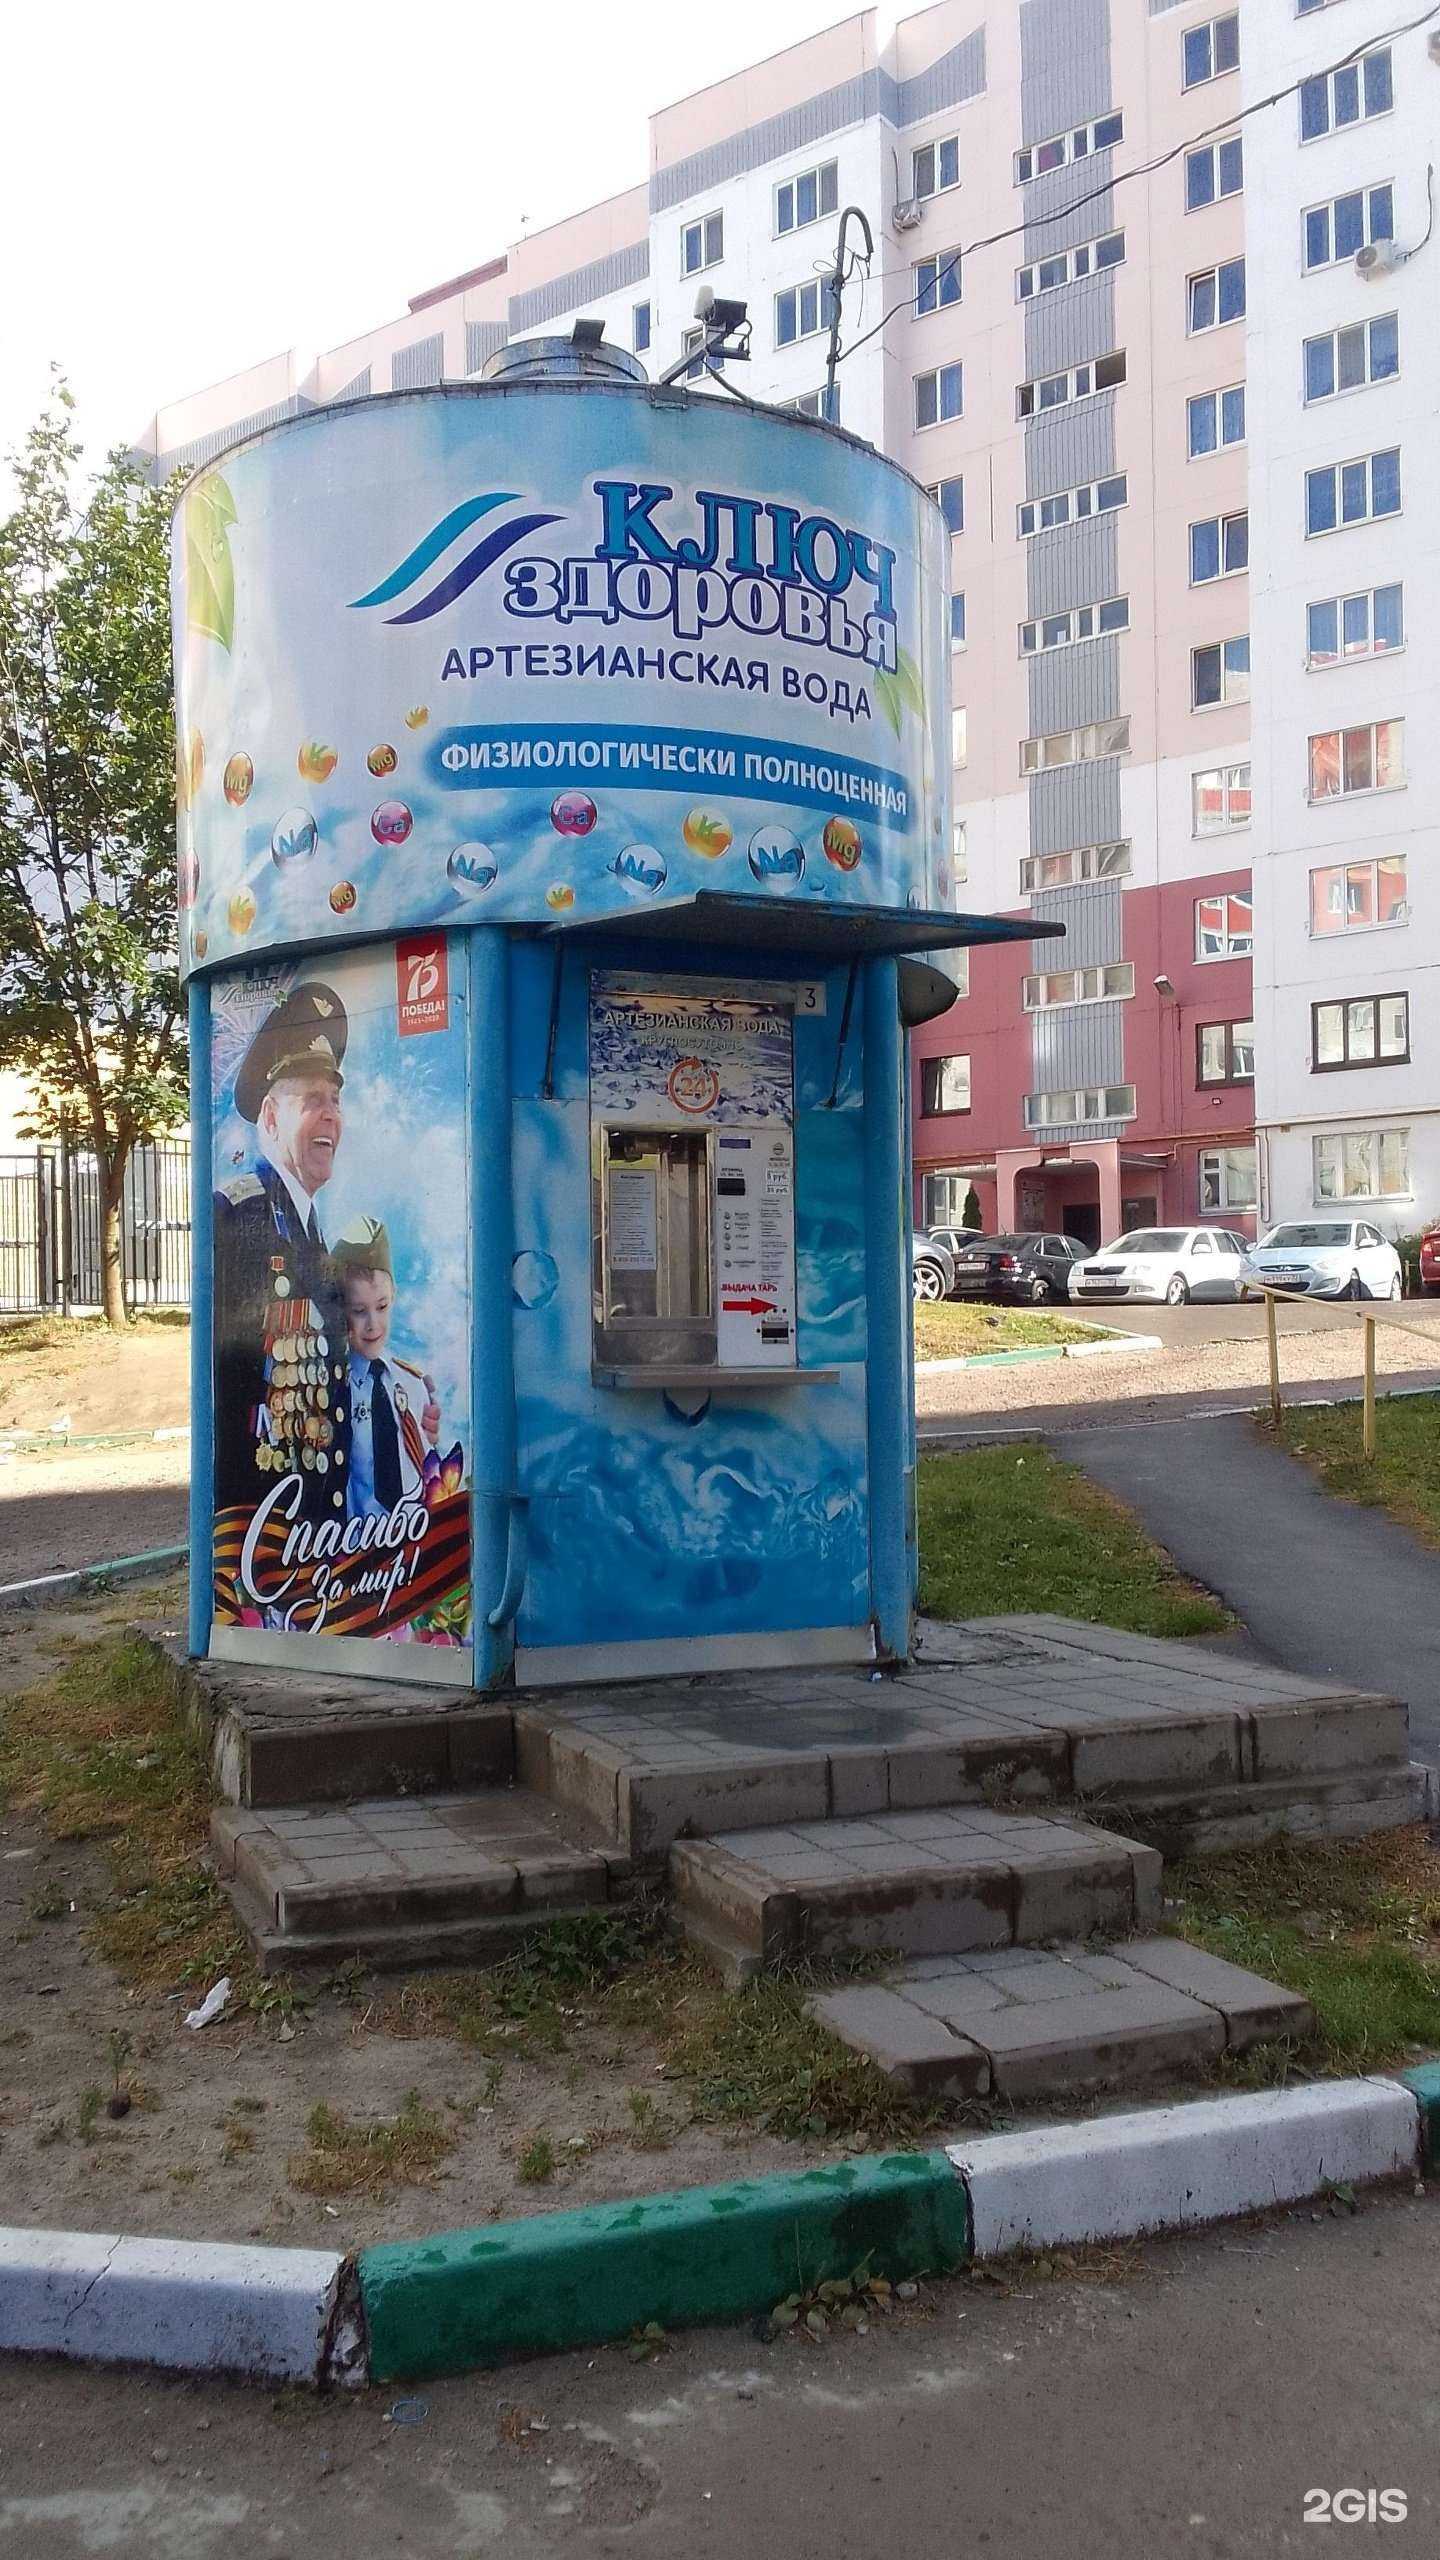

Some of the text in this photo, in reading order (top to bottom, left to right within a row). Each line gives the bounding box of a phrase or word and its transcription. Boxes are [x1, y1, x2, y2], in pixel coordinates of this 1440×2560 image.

[441, 644, 872, 722] АРТЕЗИАНСКАЯ ВОДА
[441, 739, 907, 815] ФИЗИОЛОГИЧЕСКИ ПОЛНОЦЕННАЯ
[378, 815, 405, 834] Ca
[559, 804, 589, 825] Ca
[407, 949, 439, 1001] 75
[402, 999, 446, 1018] ПОБЕДА!
[804, 987, 816, 1008] 3
[603, 1011, 734, 1033] АРТЕЗИАНСКАЯ
[720, 1283, 756, 1293] ВЫДАЧА
[241, 1473, 430, 1604] Спасибо
[350, 1546, 420, 1617] мир!
